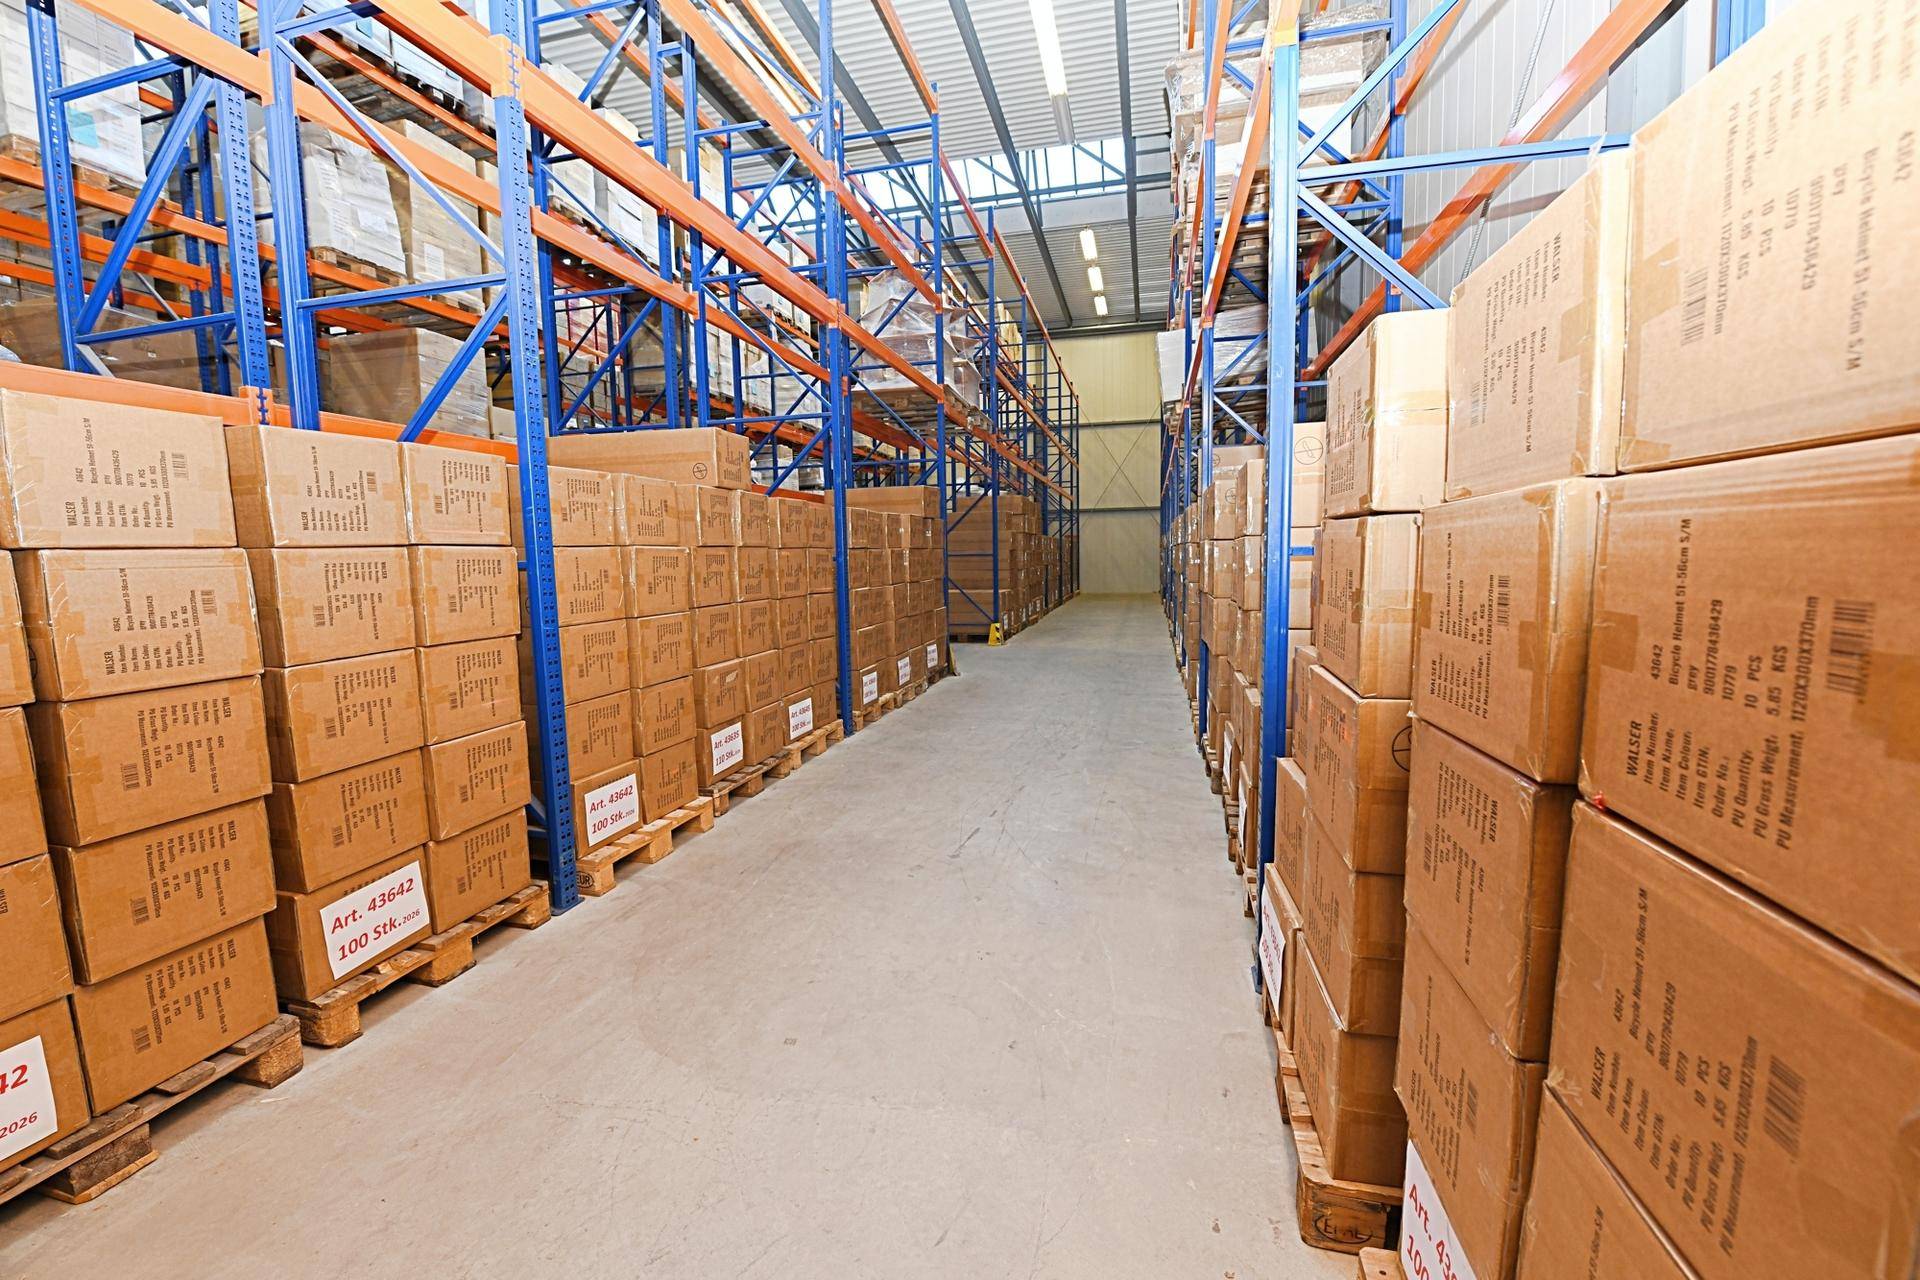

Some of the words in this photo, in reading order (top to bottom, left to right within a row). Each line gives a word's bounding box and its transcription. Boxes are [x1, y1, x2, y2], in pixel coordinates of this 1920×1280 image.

[1680, 519, 1691, 543] S/M
[1676, 547, 1688, 596] 51-56cm
[1673, 602, 1684, 640] Helmet
[1668, 645, 1681, 685] Bicycle
[1747, 656, 1762, 681] PCS
[1771, 646, 1787, 672] KGS
[1644, 759, 1654, 784] Item
[1651, 645, 1662, 679] 43642
[1744, 694, 1758, 708] 10
[1766, 687, 1781, 716] 5.85
[1675, 774, 1687, 800] Item
[1687, 665, 1699, 690] grey
[1712, 785, 1725, 817] Order
[1722, 665, 1736, 700] 10779
[1627, 721, 1641, 775] WALSER
[1659, 766, 1670, 792] Item
[590, 801, 606, 814] Art.
[608, 785, 633, 804] 43642
[1693, 781, 1705, 808] Item
[1756, 780, 1772, 816] Gross
[592, 818, 608, 834] 100
[610, 810, 625, 825] Stk.
[1732, 809, 1745, 828] PU
[1753, 818, 1767, 838] PU
[1776, 829, 1791, 850] PU
[331, 909, 363, 934] Art.
[367, 878, 414, 912] 43642
[338, 933, 369, 961] 100
[373, 917, 402, 941] Stk.
[402, 908, 420, 924] 2026
[1409, 1184, 1431, 1242] Art.
